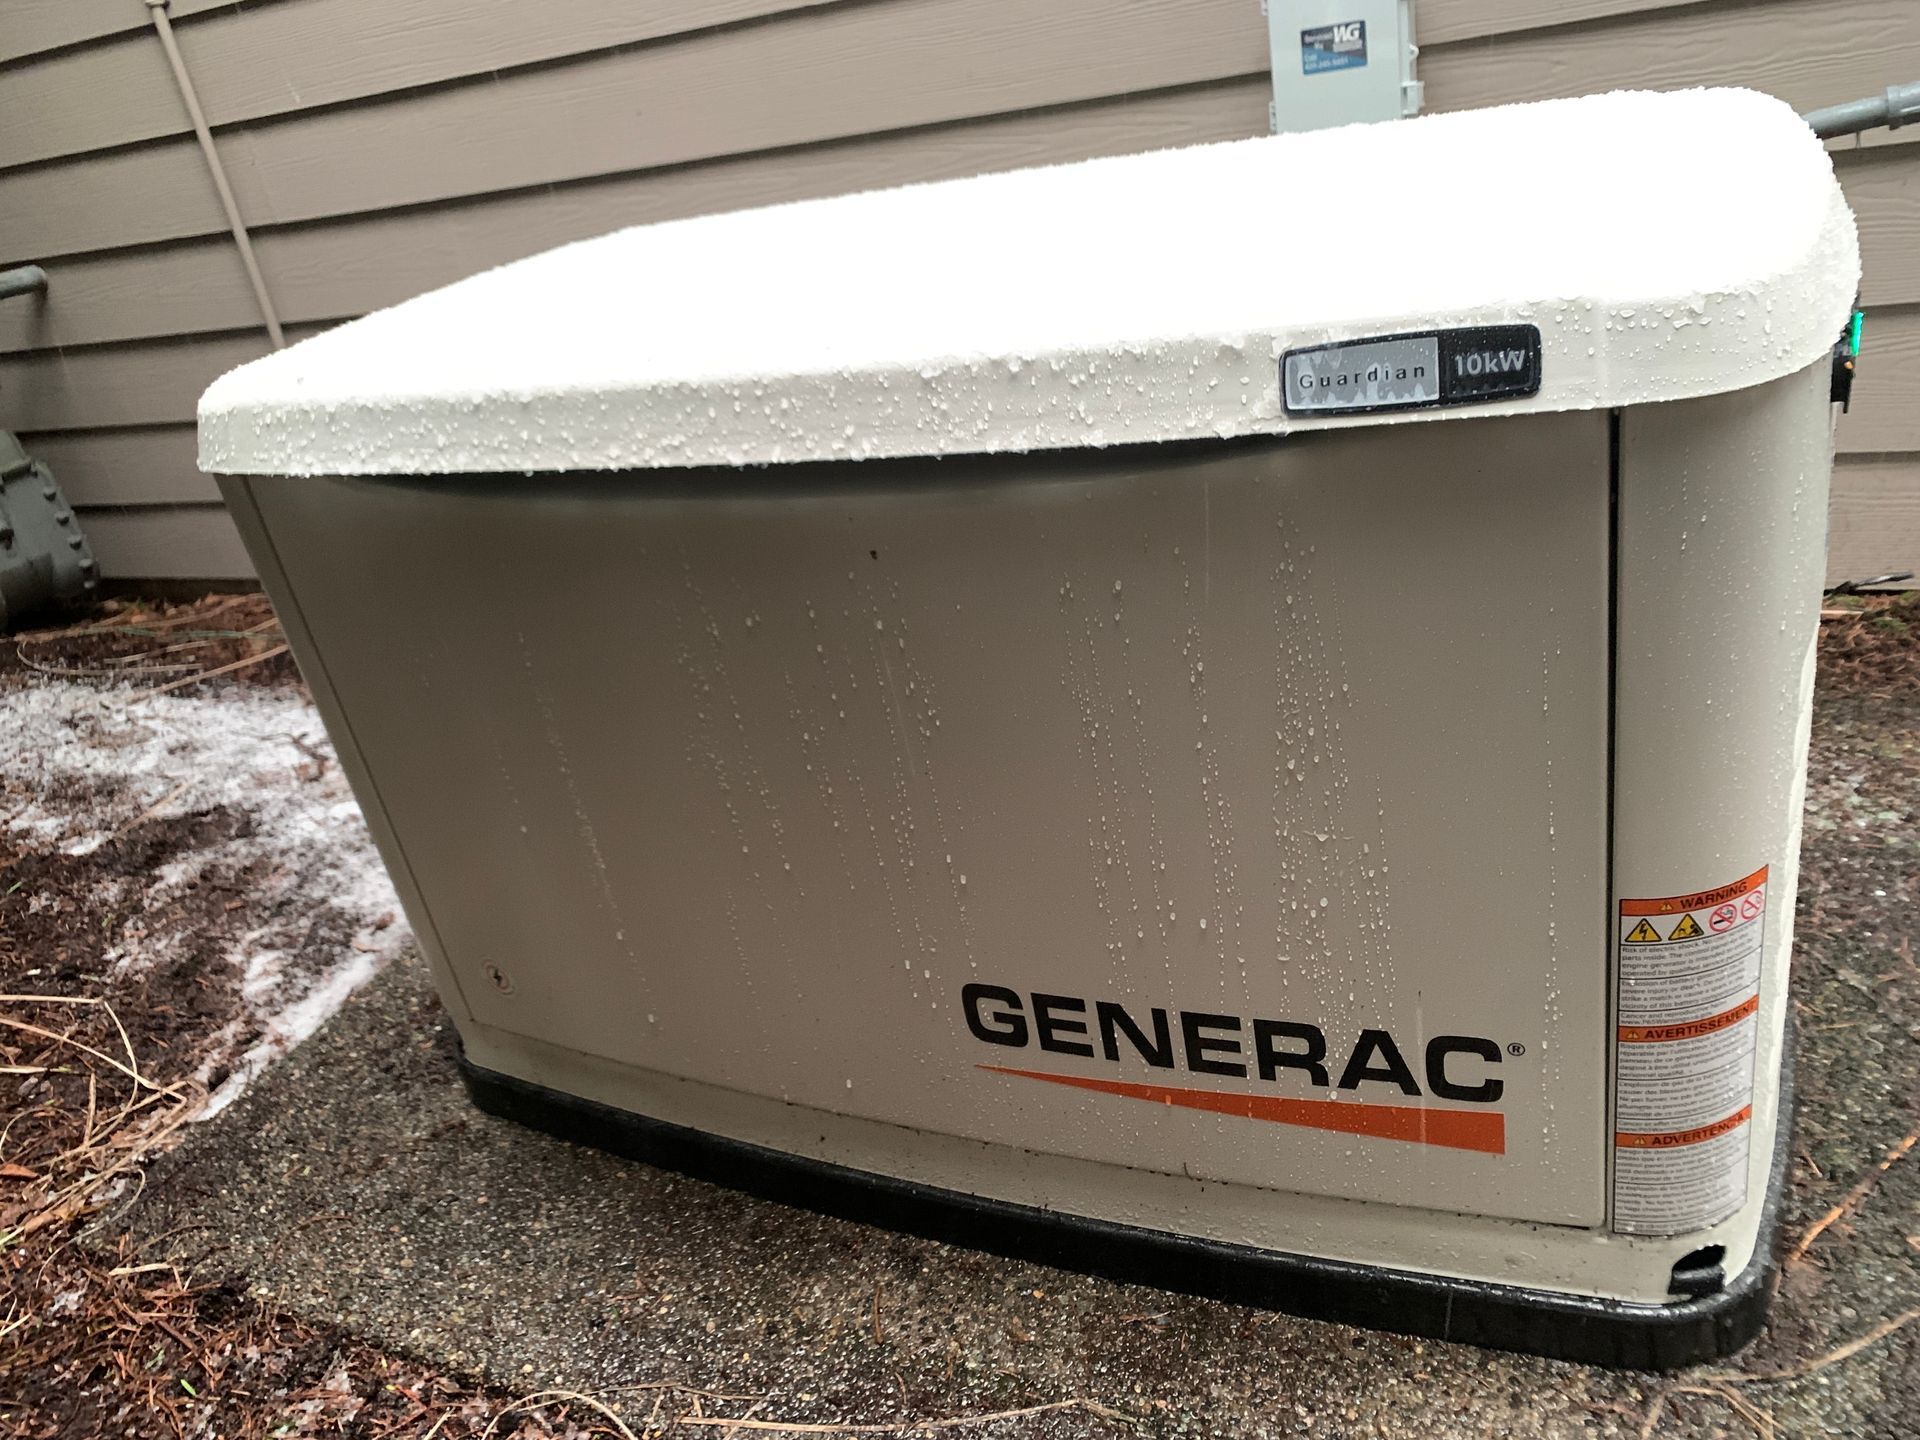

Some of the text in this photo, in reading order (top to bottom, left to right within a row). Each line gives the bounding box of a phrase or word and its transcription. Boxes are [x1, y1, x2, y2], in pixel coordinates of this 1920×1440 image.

[1333, 23, 1361, 43] WG
[1299, 349, 1526, 390] Guardian 10kW
[1680, 881, 1748, 909] WARNING
[961, 983, 1505, 1103] GENERAC
